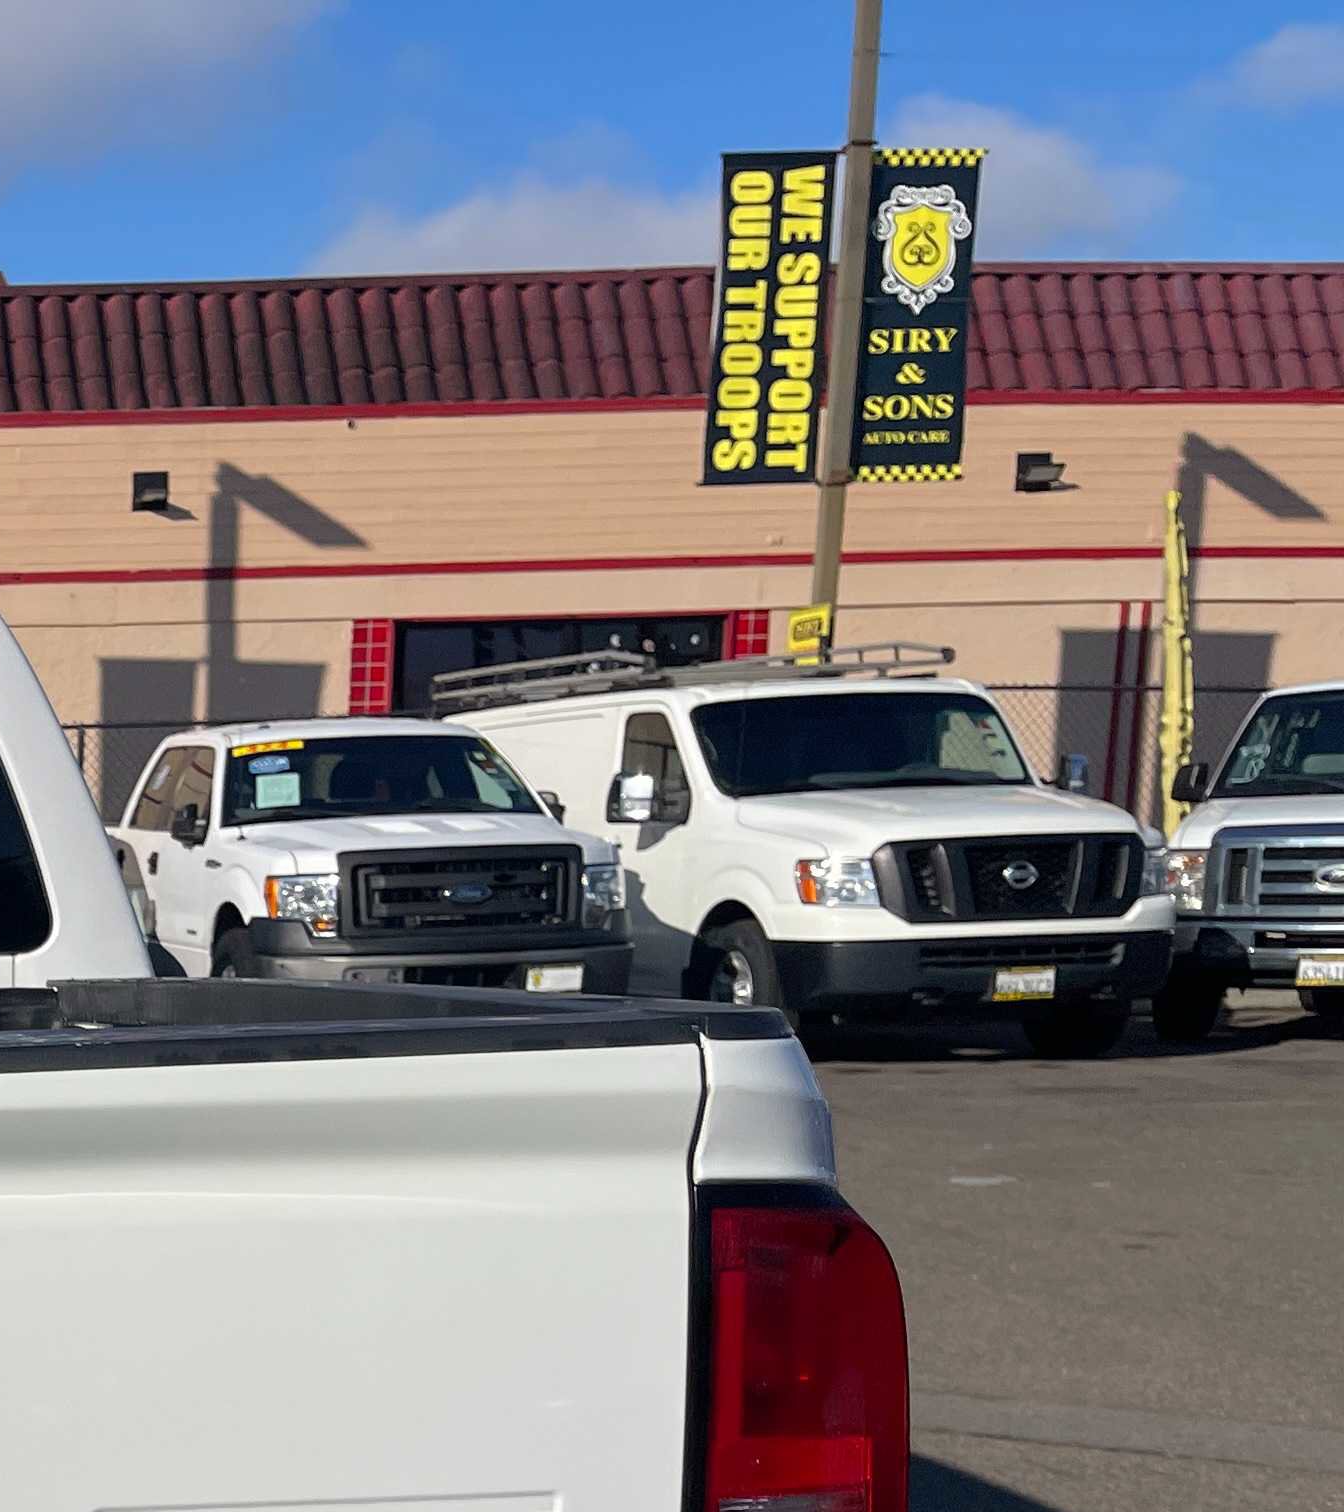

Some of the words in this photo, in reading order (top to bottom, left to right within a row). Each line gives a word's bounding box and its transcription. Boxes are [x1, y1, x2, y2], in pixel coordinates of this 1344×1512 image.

[727, 169, 775, 272] OUR
[780, 164, 826, 245] WE
[764, 251, 821, 474] SUPPORT
[868, 327, 959, 354] SIRY
[712, 279, 768, 473] TROOPS
[895, 362, 927, 385] &
[862, 394, 955, 421] SONS
[907, 429, 951, 444] CARE
